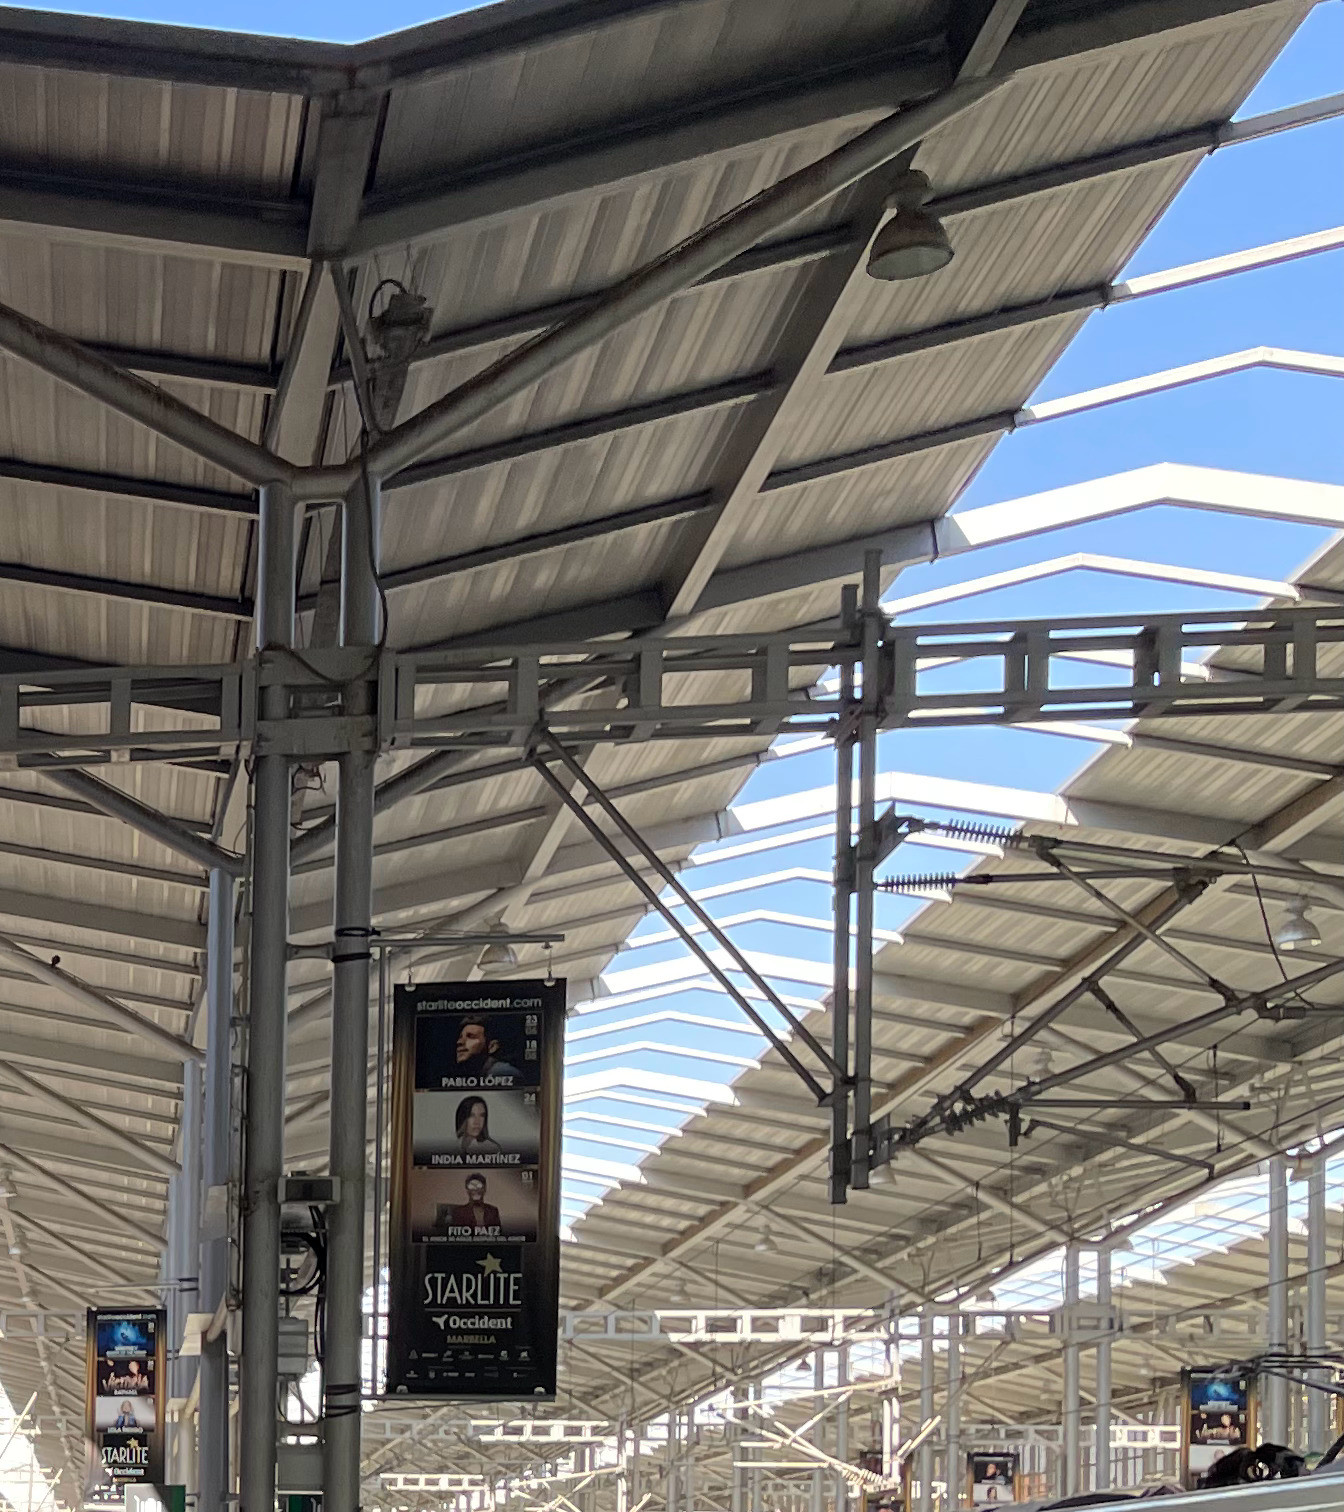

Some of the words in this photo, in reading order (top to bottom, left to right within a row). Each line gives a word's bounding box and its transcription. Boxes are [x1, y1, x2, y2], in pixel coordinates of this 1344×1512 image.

[417, 997, 542, 1011] starliteoccident.com
[441, 1076, 478, 1087] PABLO
[480, 1073, 514, 1086] LÓPEZ
[431, 1154, 463, 1165] INDIA
[465, 1151, 521, 1165] MARTÍNEZ
[448, 1226, 471, 1236] FITO
[474, 1226, 501, 1236] PAEZ
[423, 1272, 523, 1305] STARLITE
[449, 1315, 513, 1329] Occident
[101, 1446, 149, 1464] STARLITE
